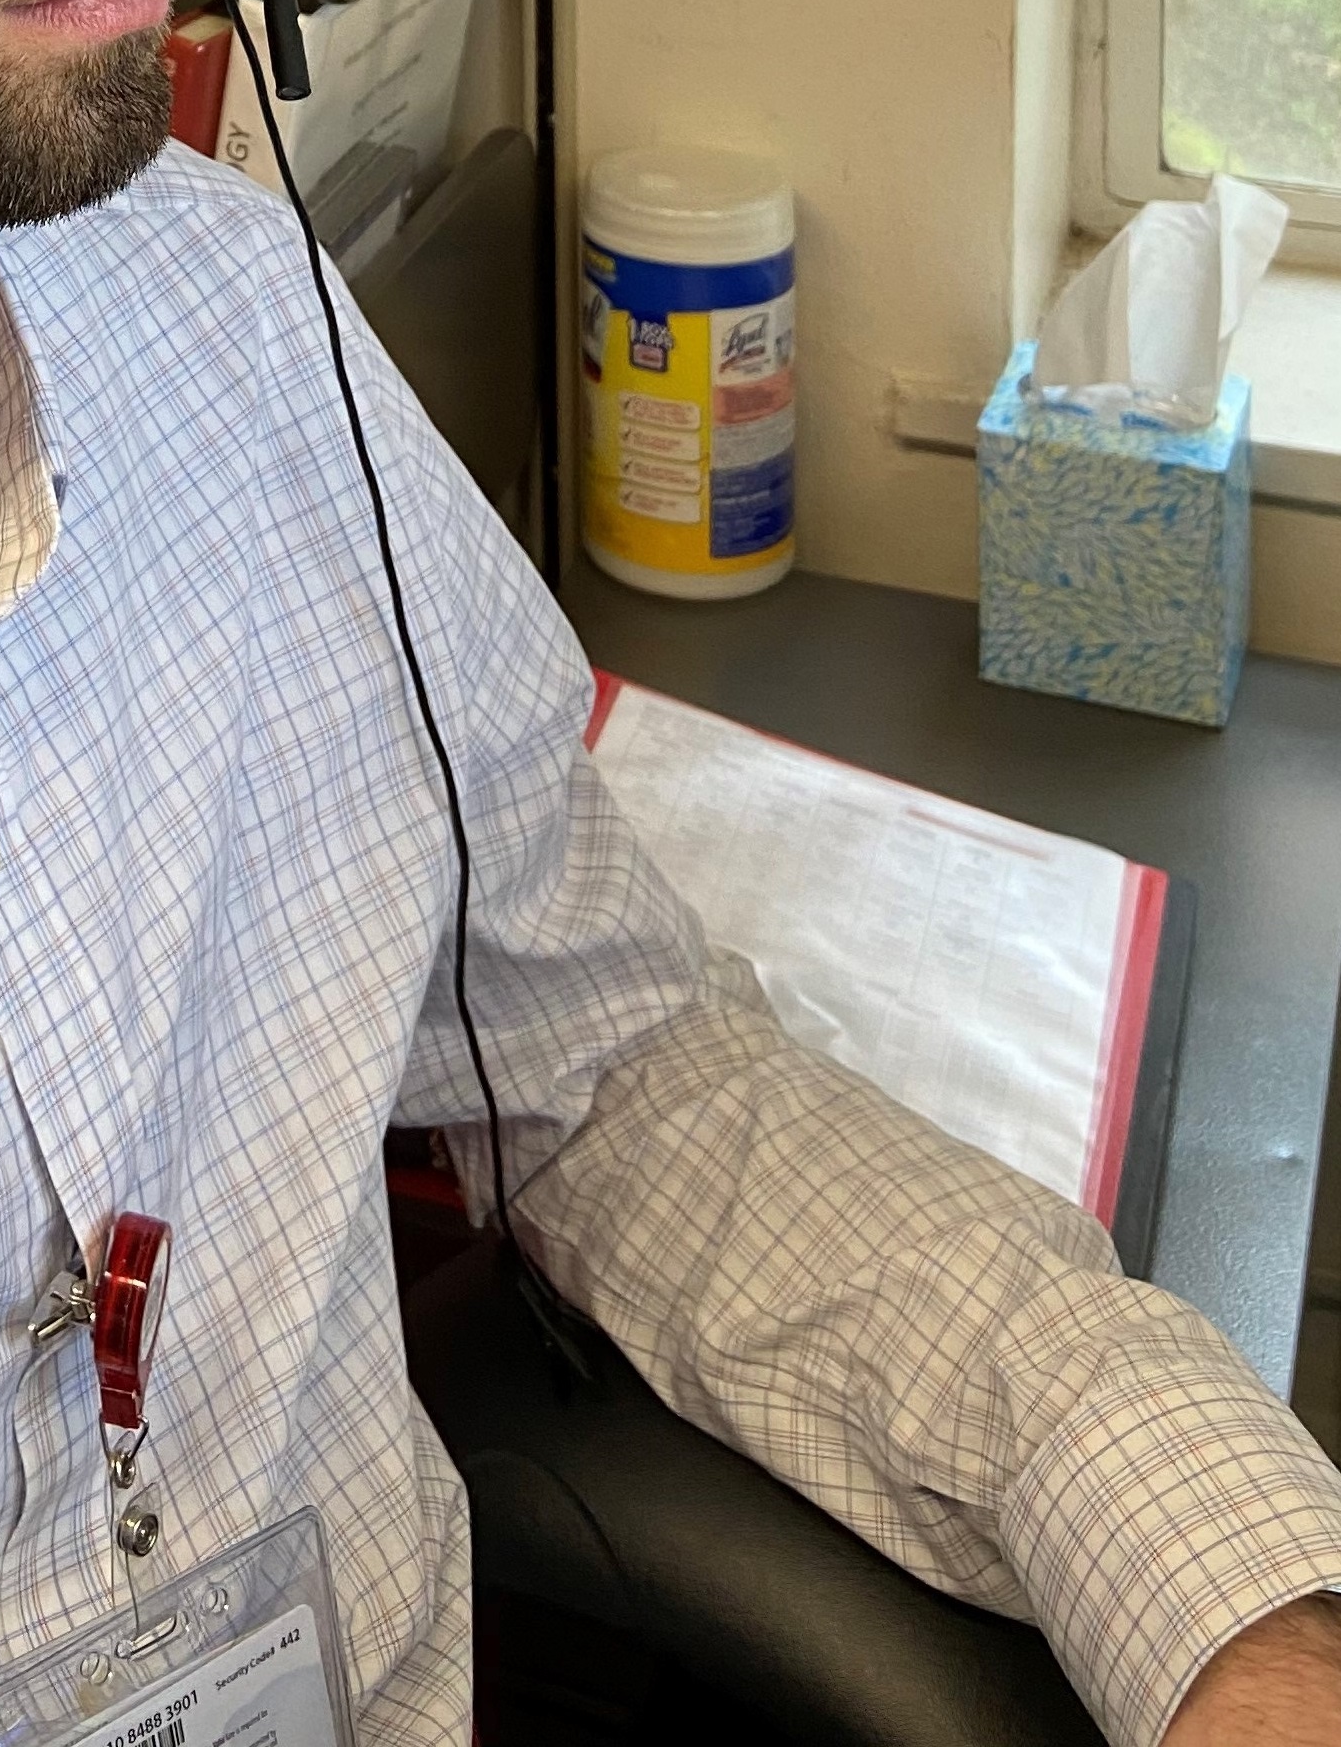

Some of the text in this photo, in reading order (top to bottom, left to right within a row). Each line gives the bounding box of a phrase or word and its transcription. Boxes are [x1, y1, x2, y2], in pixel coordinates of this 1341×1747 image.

[226, 121, 250, 171] GY
[215, 1663, 250, 1691] Security
[279, 1628, 301, 1650] 442
[127, 1713, 162, 1744] 8488
[165, 1689, 199, 1723] 3901
